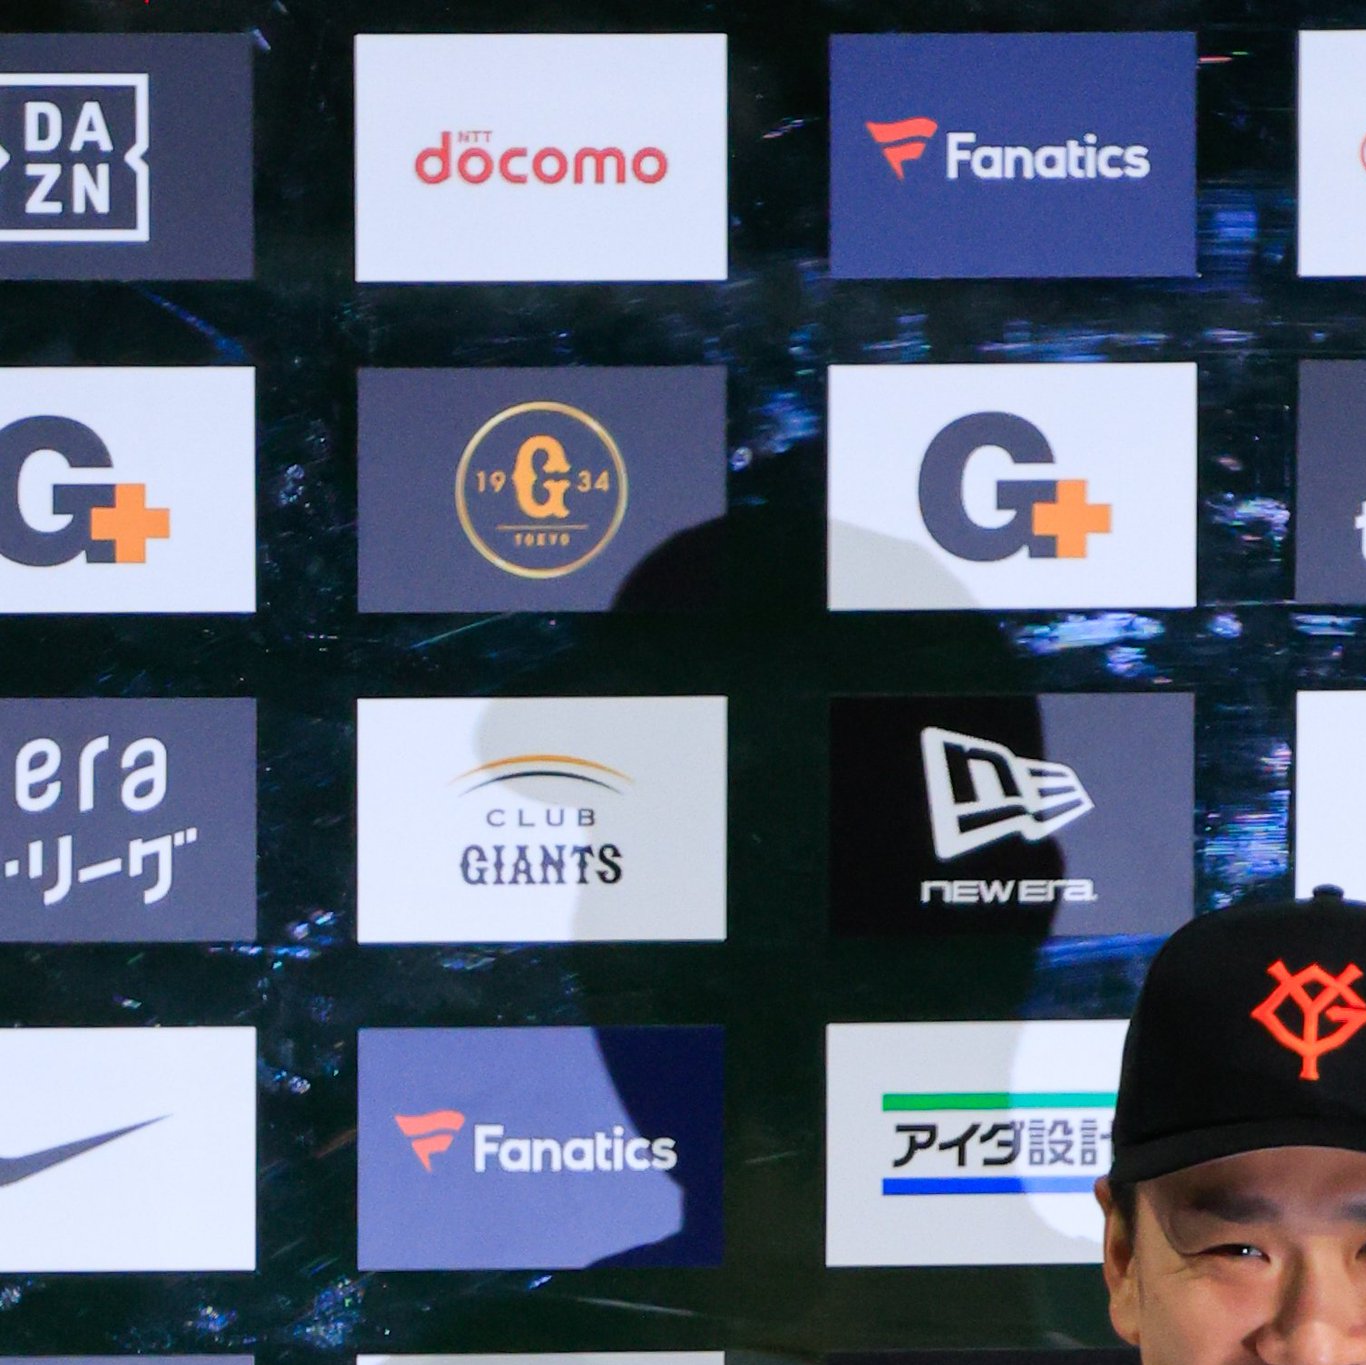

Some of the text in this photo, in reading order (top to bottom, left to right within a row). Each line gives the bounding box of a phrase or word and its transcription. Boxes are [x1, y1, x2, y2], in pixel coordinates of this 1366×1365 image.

[25, 102, 113, 152] DA
[415, 131, 668, 185] docomo
[947, 133, 1150, 179] Fanatics
[26, 164, 109, 214] ZN
[477, 436, 609, 518] 19 G 34
[16, 736, 166, 812] era
[487, 808, 597, 828] CLUB
[6, 828, 197, 905] ・リーグ
[461, 844, 622, 884] GIANTS
[474, 1125, 678, 1172] Fanatics
